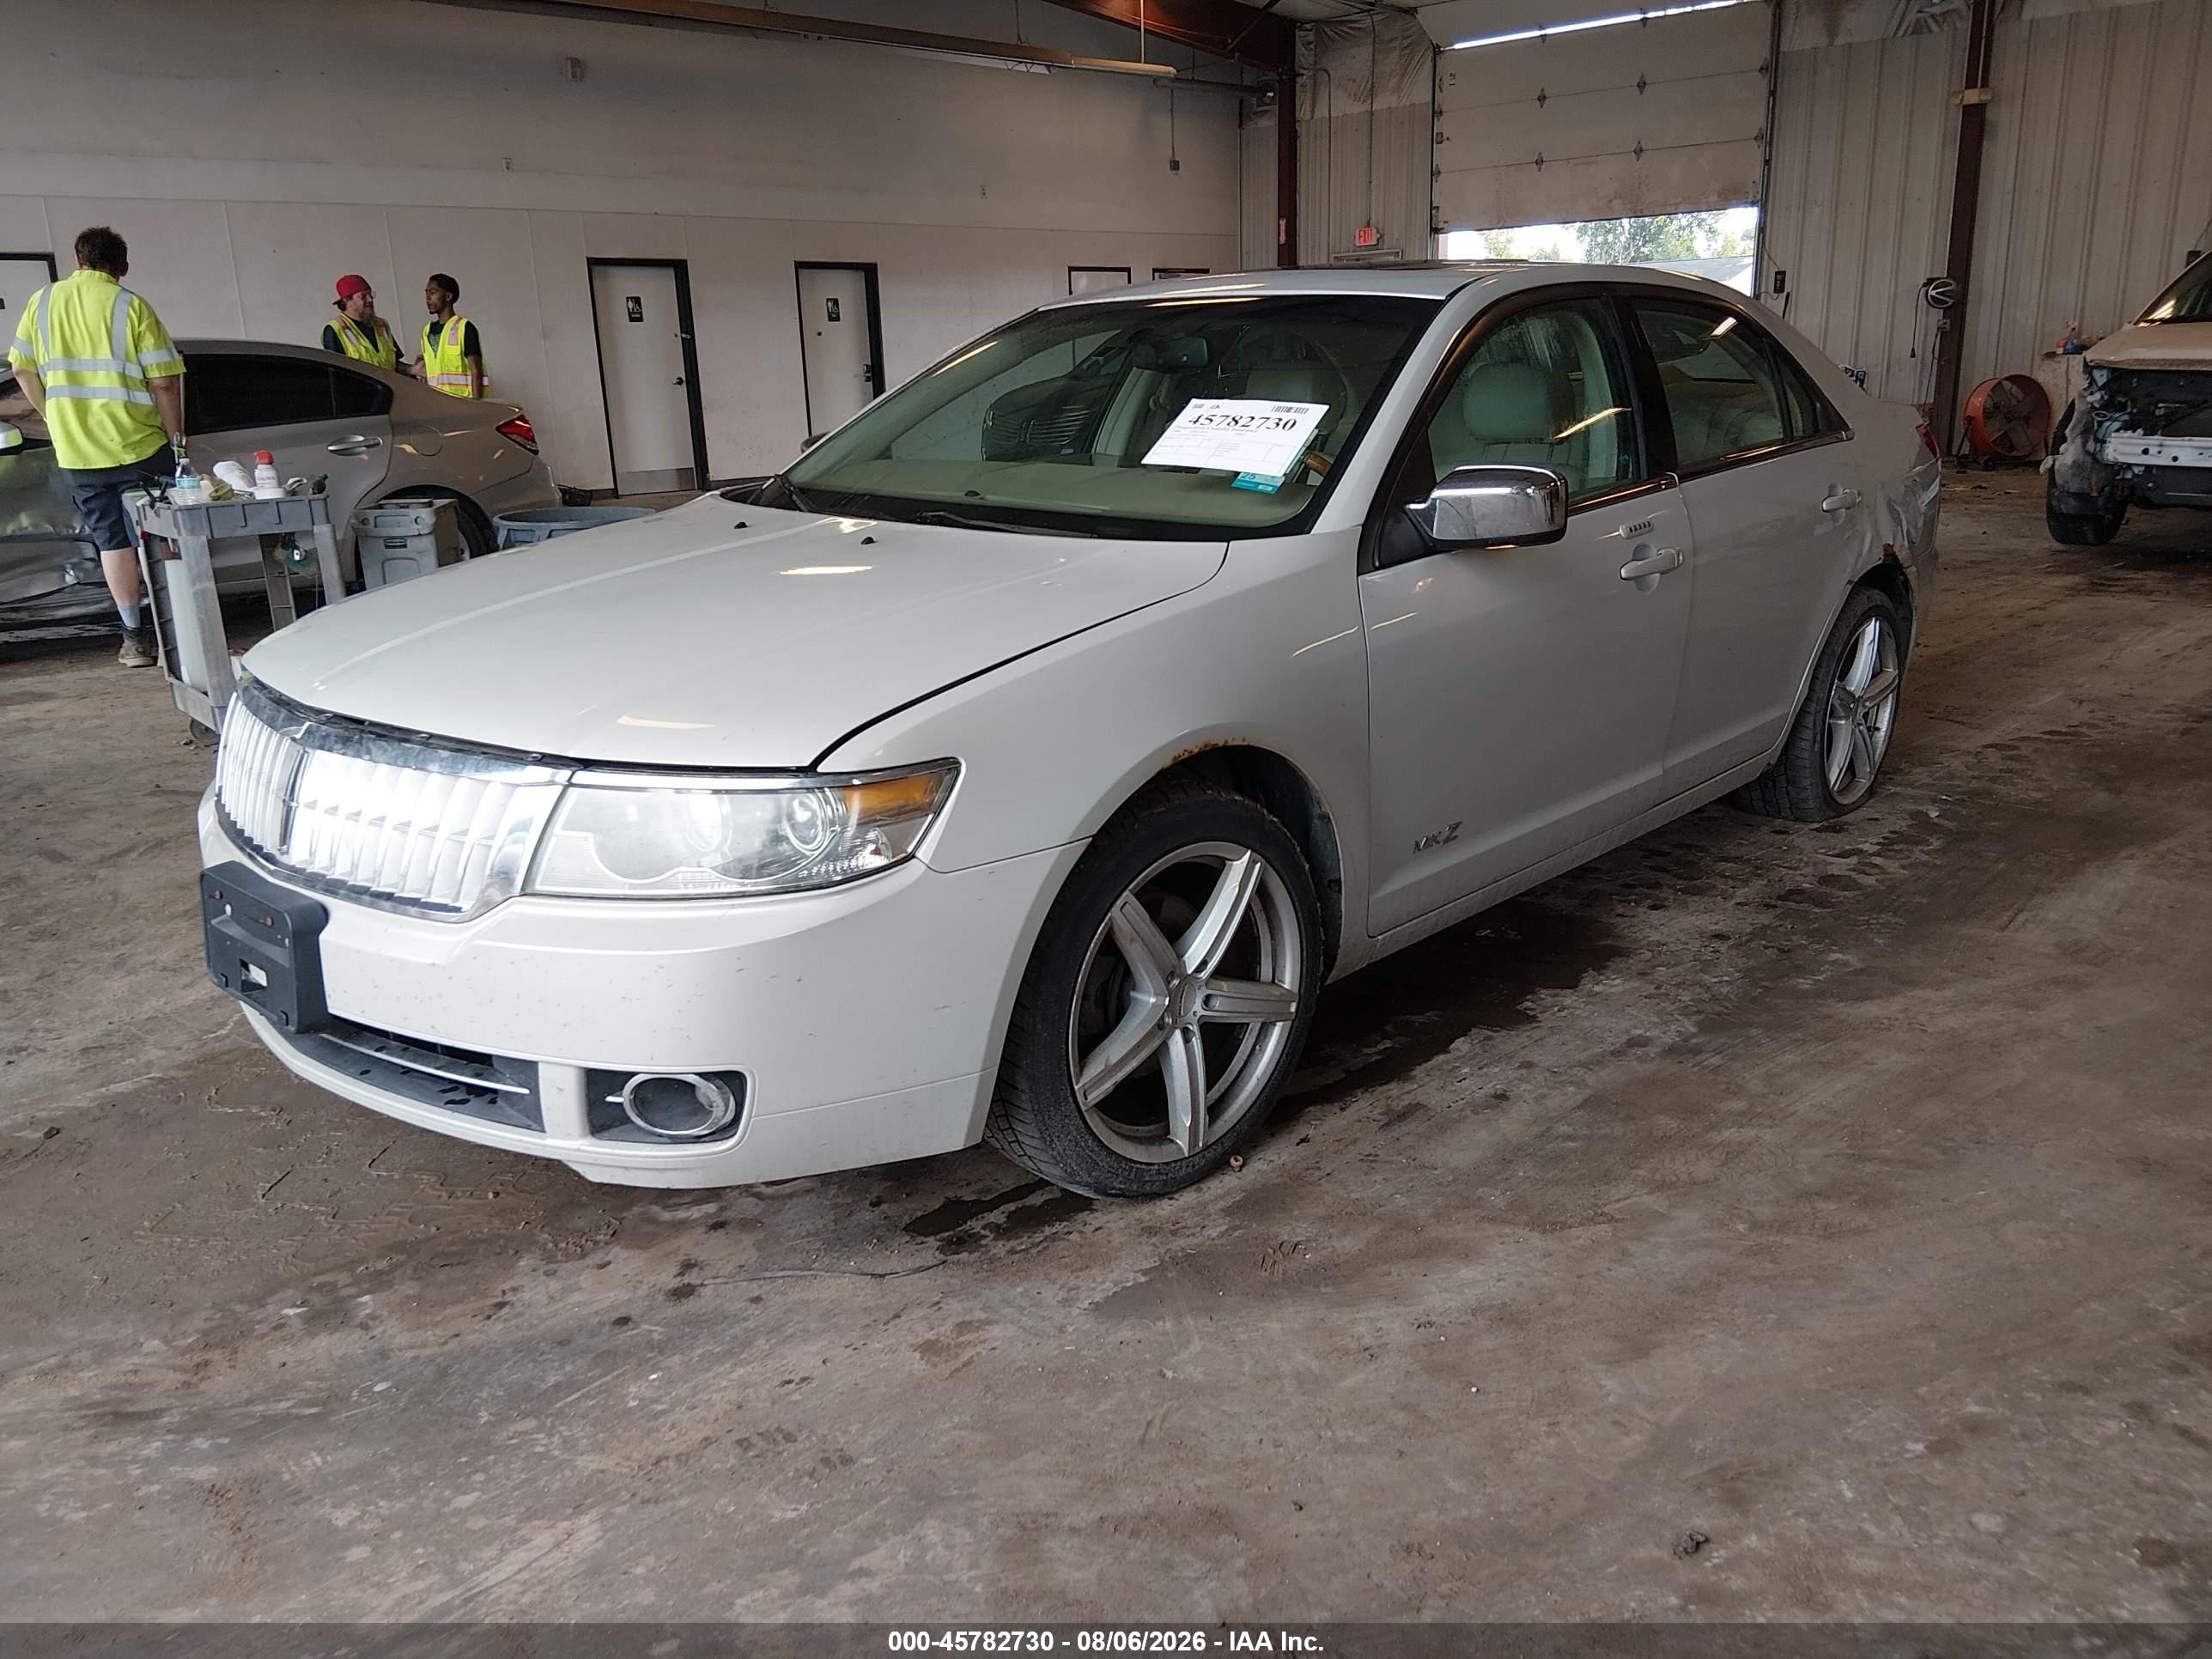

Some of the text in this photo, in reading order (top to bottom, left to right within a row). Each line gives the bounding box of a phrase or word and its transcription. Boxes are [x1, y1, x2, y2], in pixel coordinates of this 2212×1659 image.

[1358, 228, 1374, 244] EXIT
[1188, 413, 1297, 432] 45782730
[1413, 820, 1464, 854] MKZ
